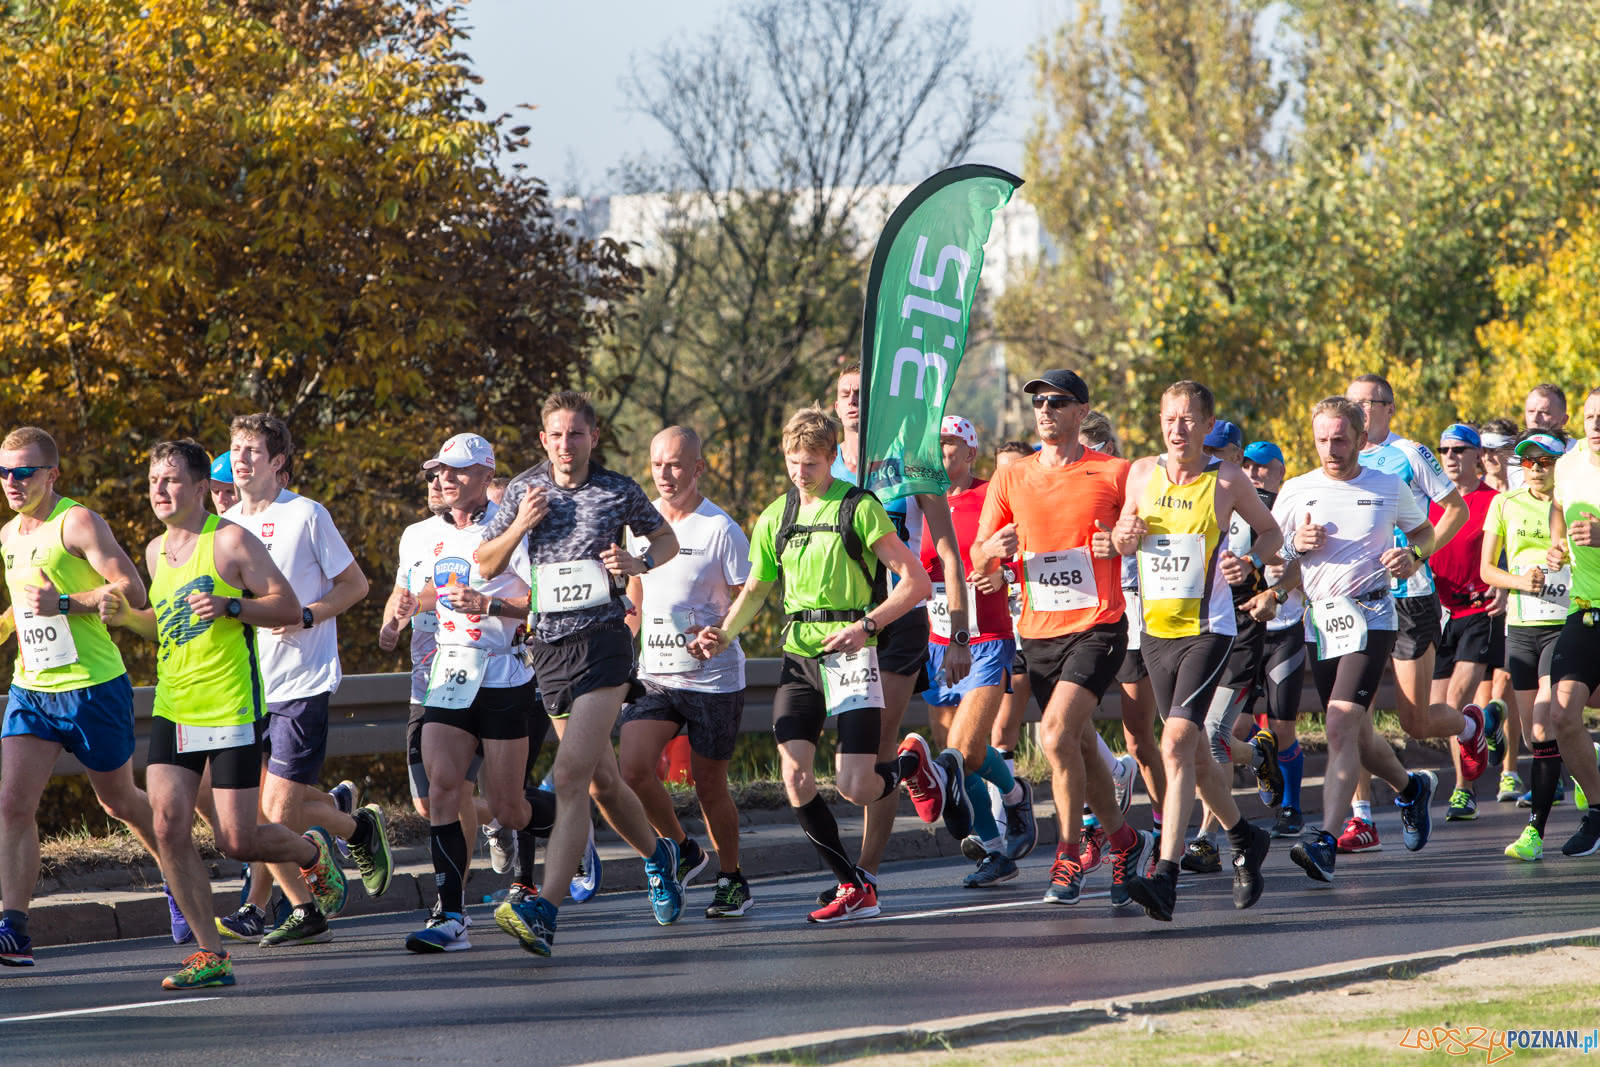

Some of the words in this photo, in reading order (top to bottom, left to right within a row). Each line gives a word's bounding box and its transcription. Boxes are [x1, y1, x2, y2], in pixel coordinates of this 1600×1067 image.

[889, 235, 971, 408] 3:15
[435, 561, 468, 577] BIEGAM
[1150, 556, 1191, 573] 3417
[1038, 569, 1083, 588] 4658
[553, 583, 593, 603] 1227
[931, 601, 949, 616] 36
[1325, 614, 1355, 633] 4950
[23, 625, 58, 645] 4190
[647, 632, 687, 649] 4440
[839, 667, 879, 688] 4425
